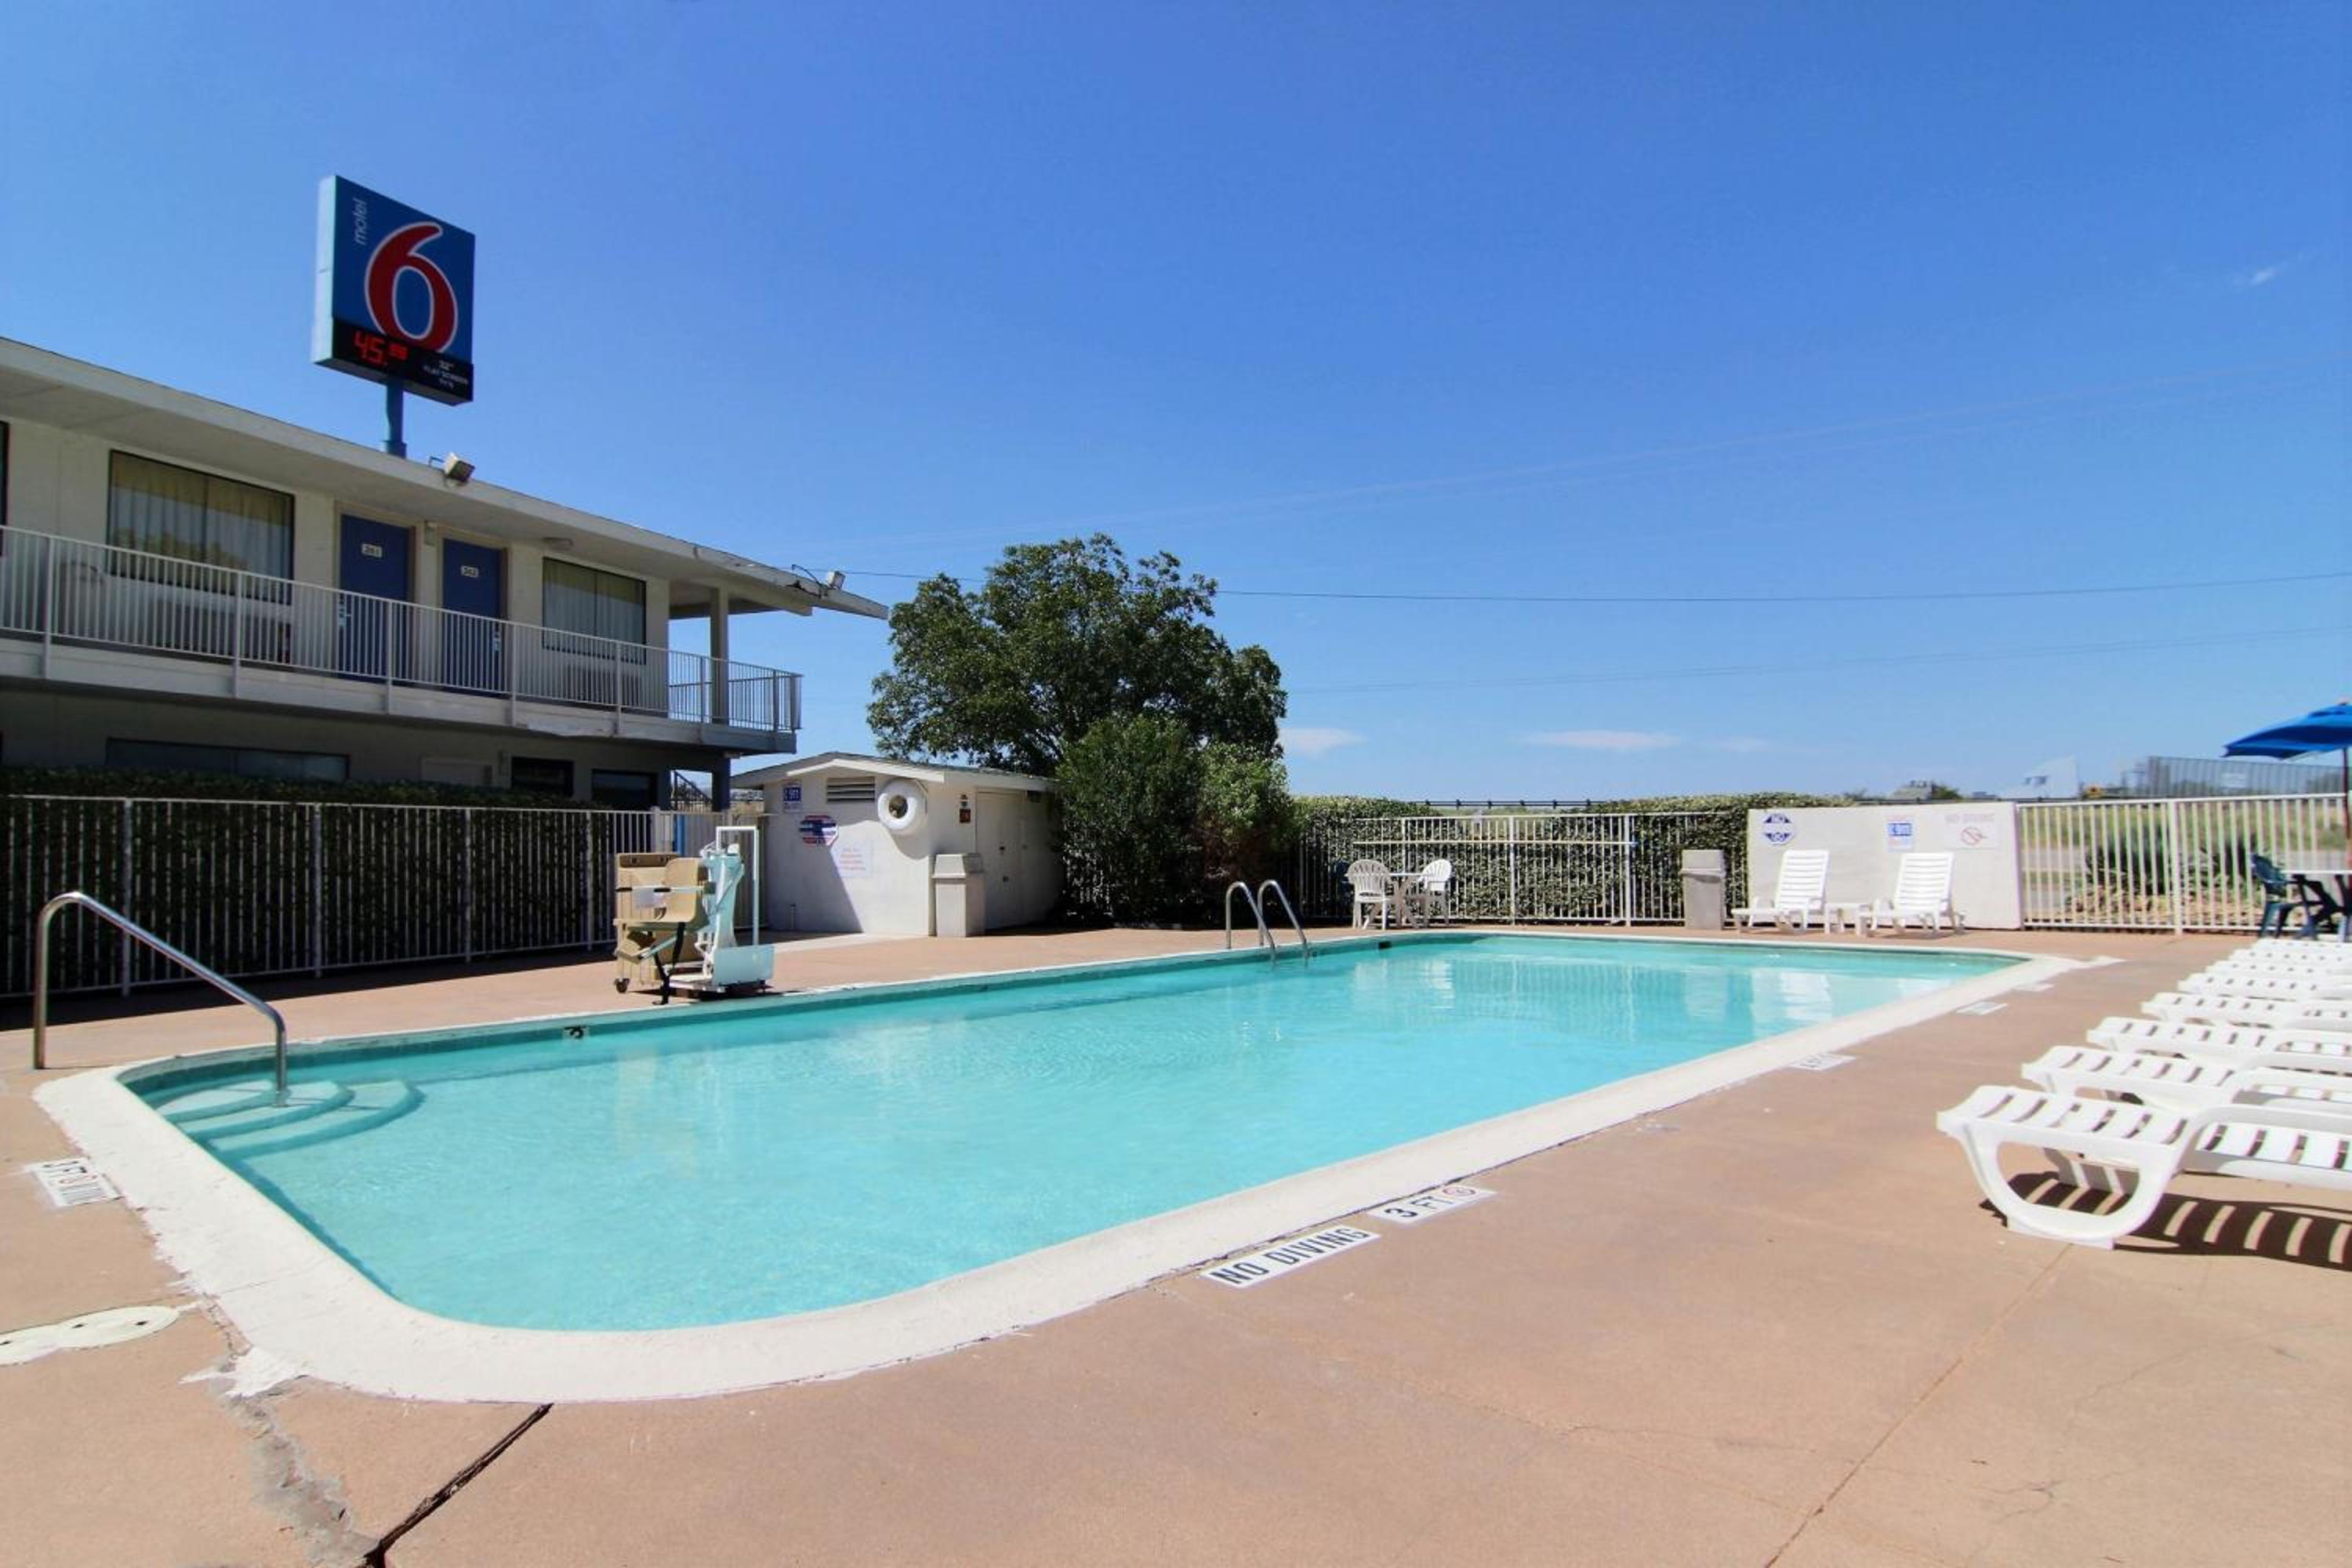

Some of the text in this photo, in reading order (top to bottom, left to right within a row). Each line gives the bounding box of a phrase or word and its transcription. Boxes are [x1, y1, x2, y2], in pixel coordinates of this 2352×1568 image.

[353, 197, 368, 246] motel
[364, 220, 459, 354] 6
[1385, 1196, 1454, 1219] 3 FT
[1209, 1228, 1370, 1285] NO DIVING
